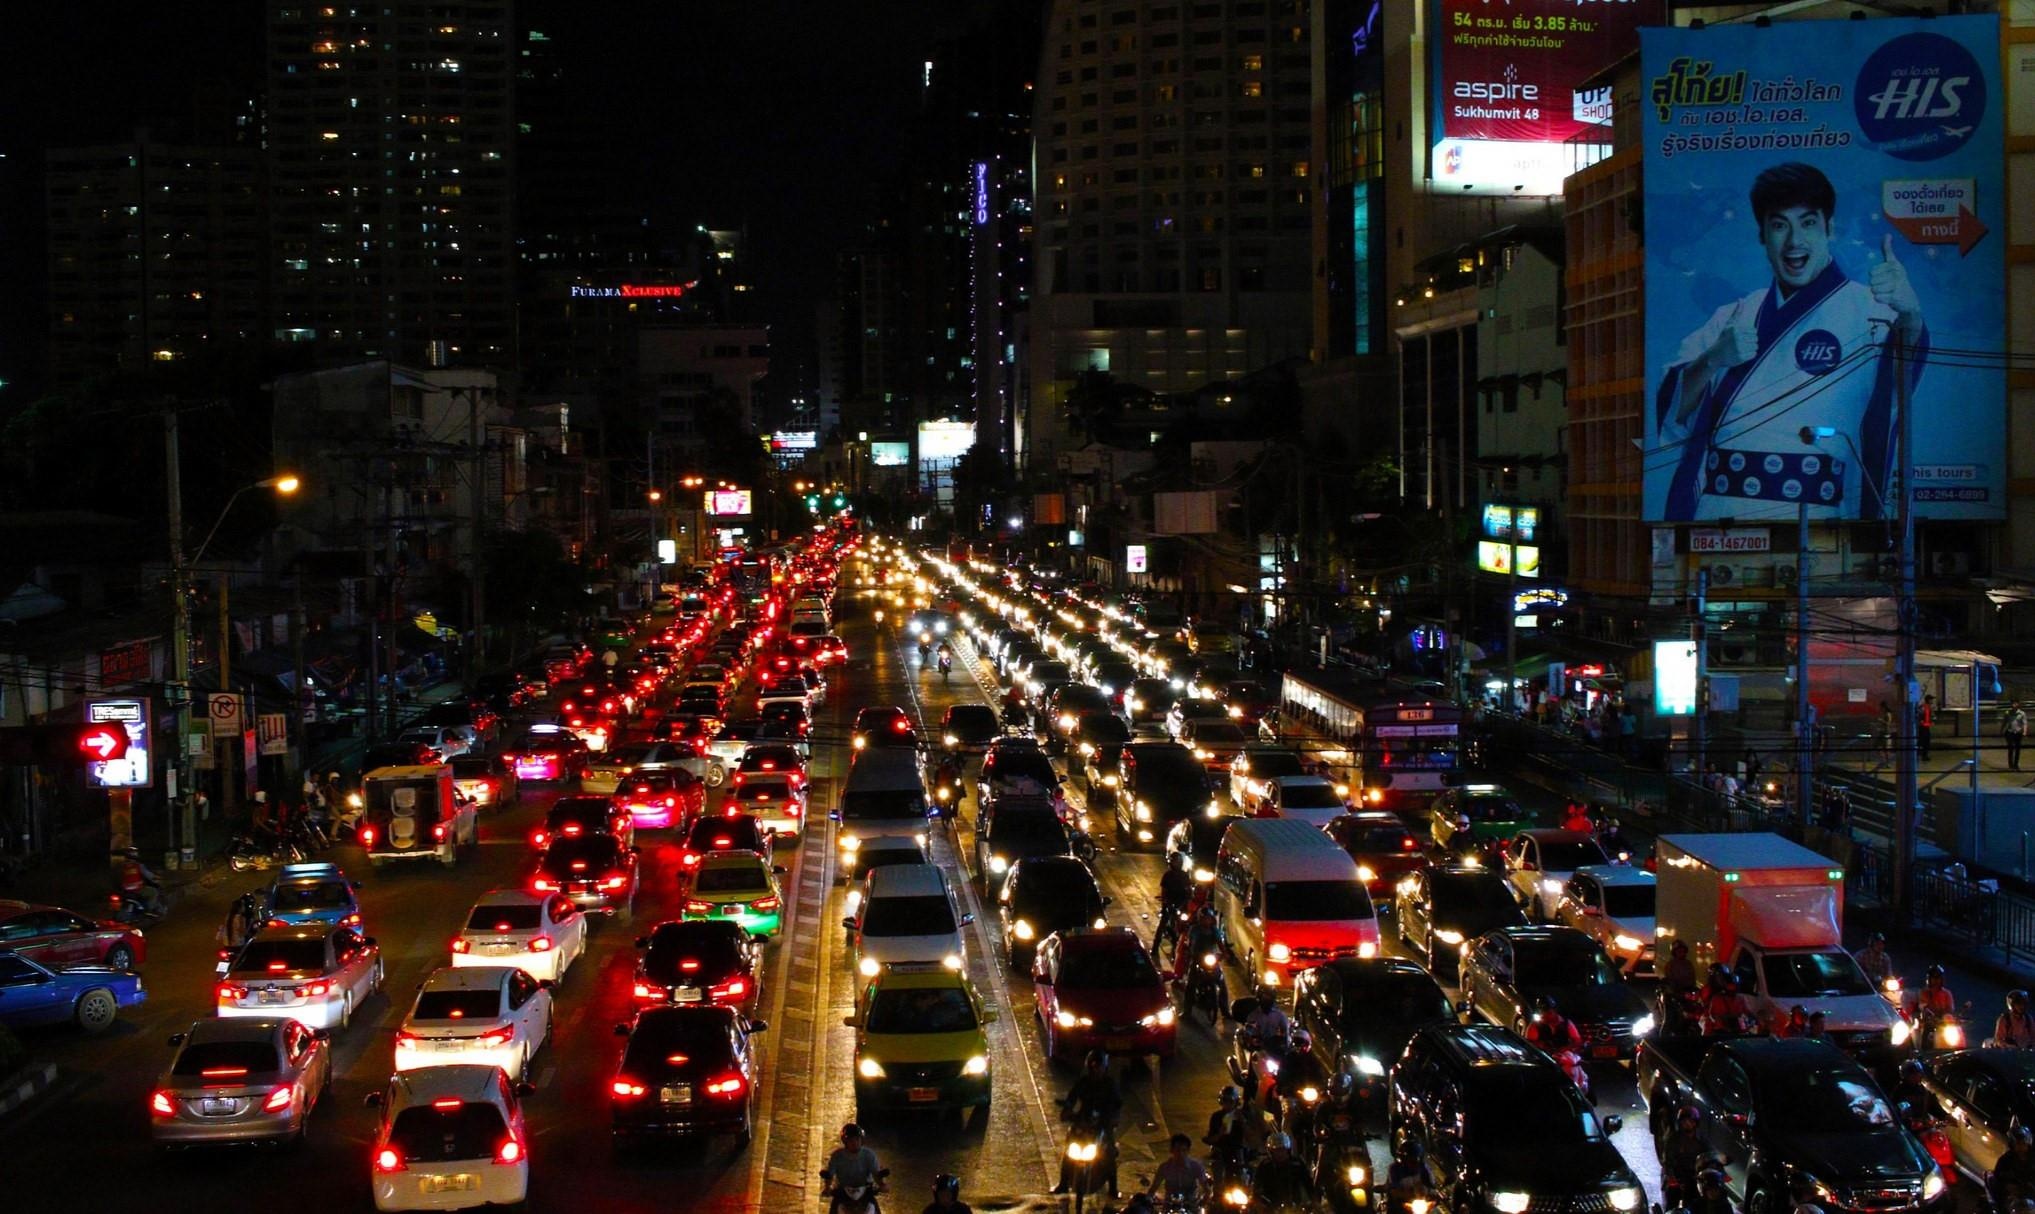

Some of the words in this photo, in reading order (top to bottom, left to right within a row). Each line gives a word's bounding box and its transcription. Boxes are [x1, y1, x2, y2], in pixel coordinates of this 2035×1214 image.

[1453, 12, 1472, 27] 54
[1534, 16, 1566, 31] 3.85
[1453, 80, 1539, 104] aspire
[1752, 76, 1842, 103] ได้ทั่วโลก
[1454, 105, 1521, 119] Sukhumvit
[1524, 108, 1540, 120] 48
[1662, 124, 1851, 157] รู้จริงเรื่องท่องเที่ยว
[1922, 219, 1960, 237] ทางนี้
[1693, 537, 1767, 550] 084-1467001
[1407, 711, 1424, 719] 136
